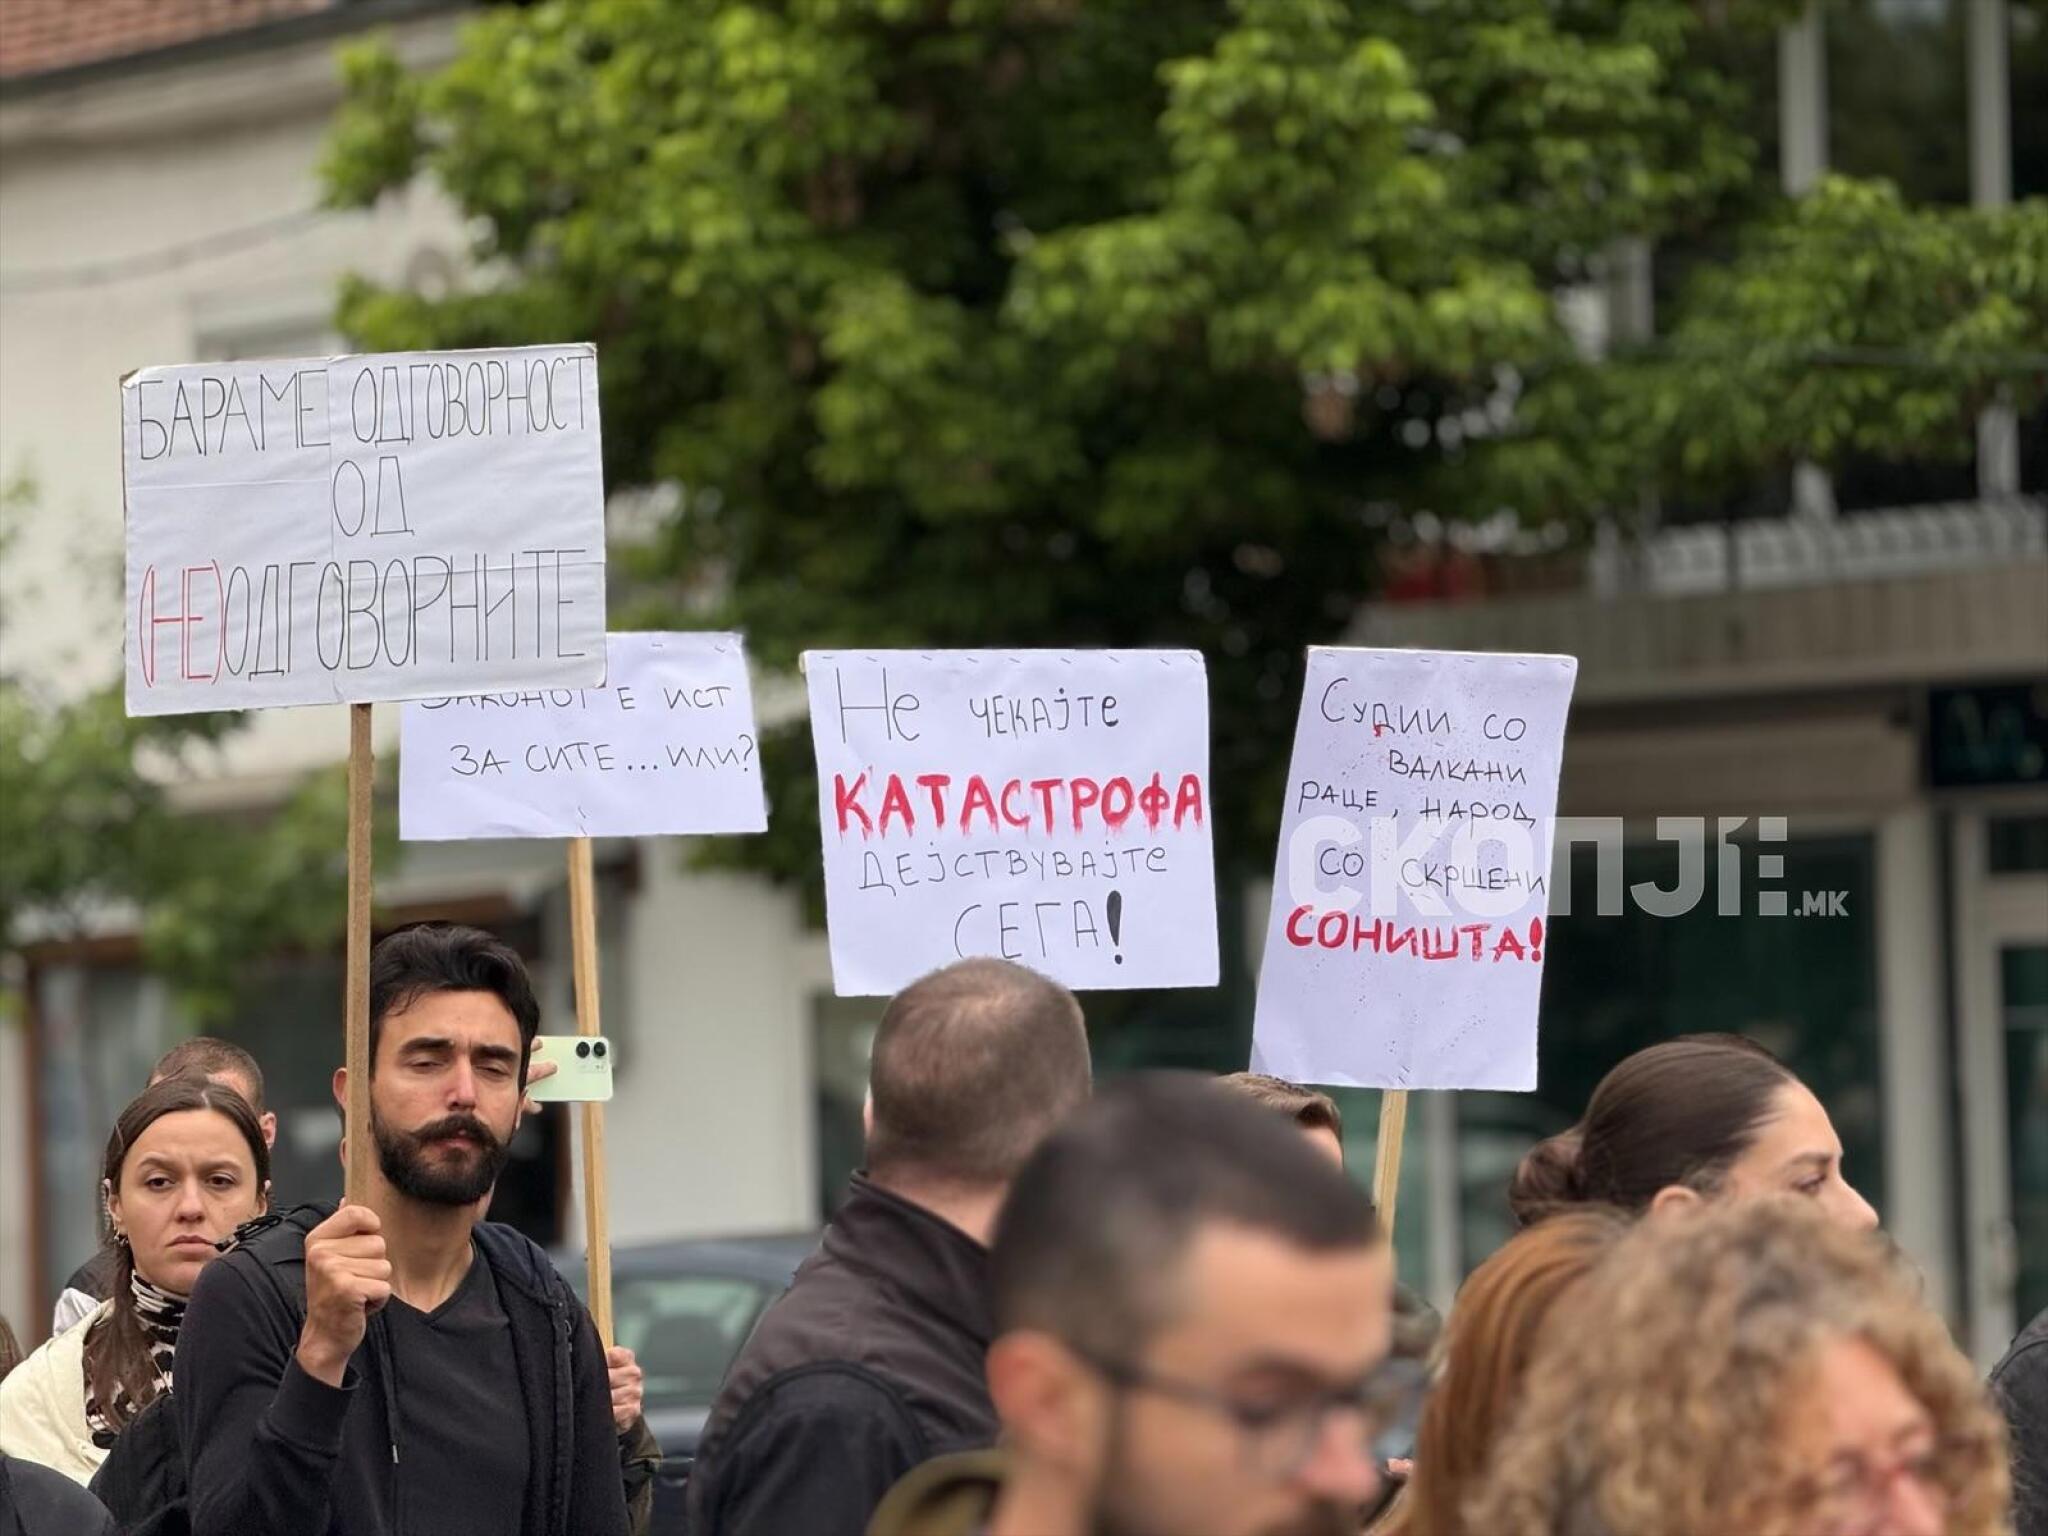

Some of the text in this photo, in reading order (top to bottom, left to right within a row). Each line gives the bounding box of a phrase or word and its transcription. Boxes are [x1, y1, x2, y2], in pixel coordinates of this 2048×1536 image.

[138, 355, 594, 460] БАРАМЕ ОДГОВОРНОСТ
[332, 455, 414, 537] ОД
[139, 549, 586, 688] (НЕ)ОДГОВОРНИТЕ
[617, 686, 636, 710] Е
[663, 686, 732, 710] ИСТ
[450, 744, 510, 776] ЗА
[833, 771, 1206, 841] КАТАСТРОФА
[953, 890, 1123, 965] СЕГА!
[1285, 904, 1544, 962] СОНИШТА!
